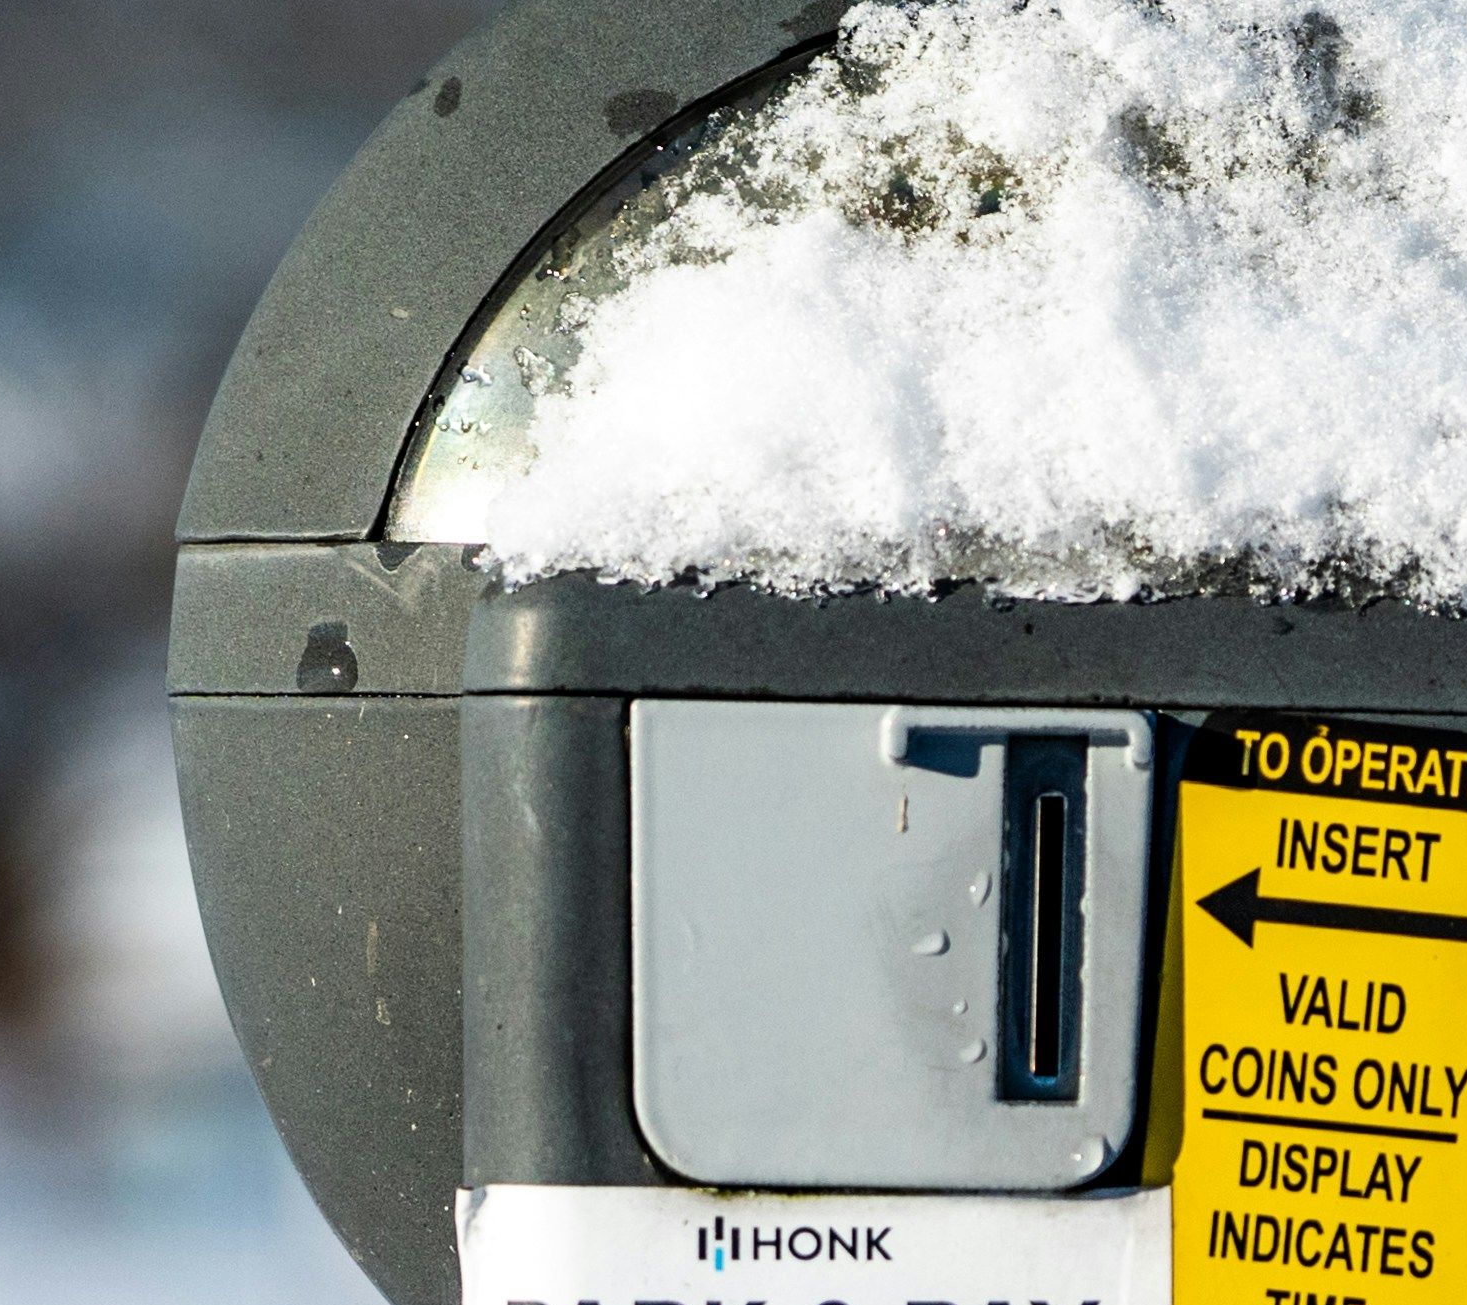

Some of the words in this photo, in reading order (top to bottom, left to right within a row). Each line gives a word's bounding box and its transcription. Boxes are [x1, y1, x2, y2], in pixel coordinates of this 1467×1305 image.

[1236, 730, 1290, 779] TO
[1277, 818, 1441, 882] INSERT
[1280, 973, 1406, 1034] VALID
[1200, 1044, 1337, 1105] COINS
[1240, 1139, 1421, 1202] DISPLAY
[753, 1227, 891, 1260] HONK
[1209, 1211, 1434, 1278] INDICATES
